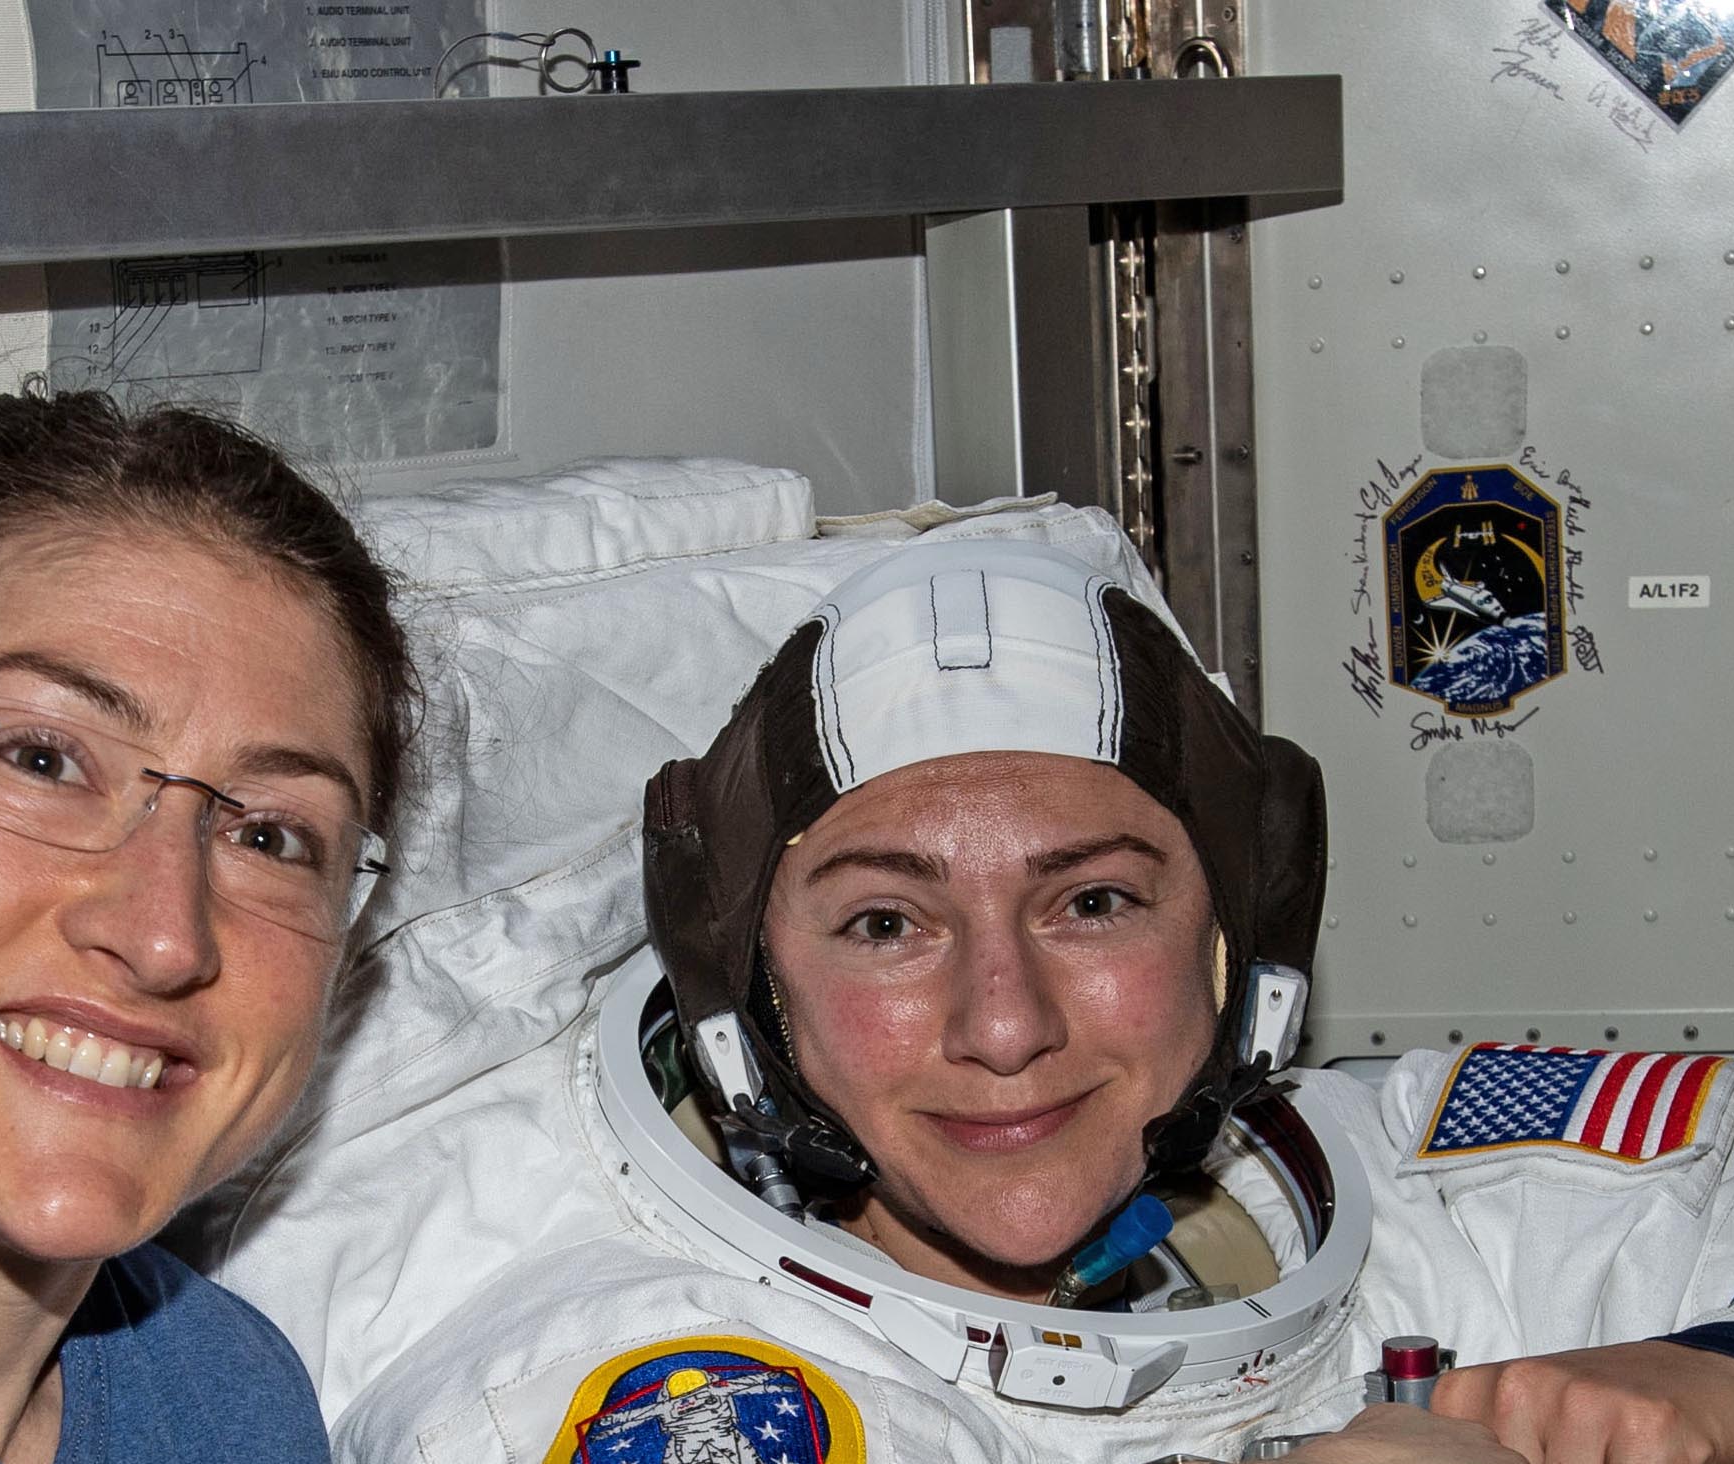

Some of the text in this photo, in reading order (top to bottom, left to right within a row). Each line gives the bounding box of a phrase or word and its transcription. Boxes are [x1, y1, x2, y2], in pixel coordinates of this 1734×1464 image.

[318, 7, 344, 15] AUDIO
[346, 6, 388, 15] TERMINAL
[390, 5, 410, 15] UNIT
[144, 29, 152, 40] 2
[168, 29, 176, 40] 3
[320, 38, 346, 47] AUDIO
[348, 38, 390, 46] TERMINAL
[392, 37, 411, 46] UNIT
[322, 69, 340, 78] EMU
[341, 68, 368, 78] AUDIO
[370, 68, 411, 77] CONTROL
[369, 313, 390, 322] TYPE
[89, 323, 100, 334] 13
[88, 344, 99, 355] 12
[87, 365, 98, 376] 11
[1389, 543, 1403, 613] KIMBROUGH
[1639, 583, 1700, 600] A/L1F2
